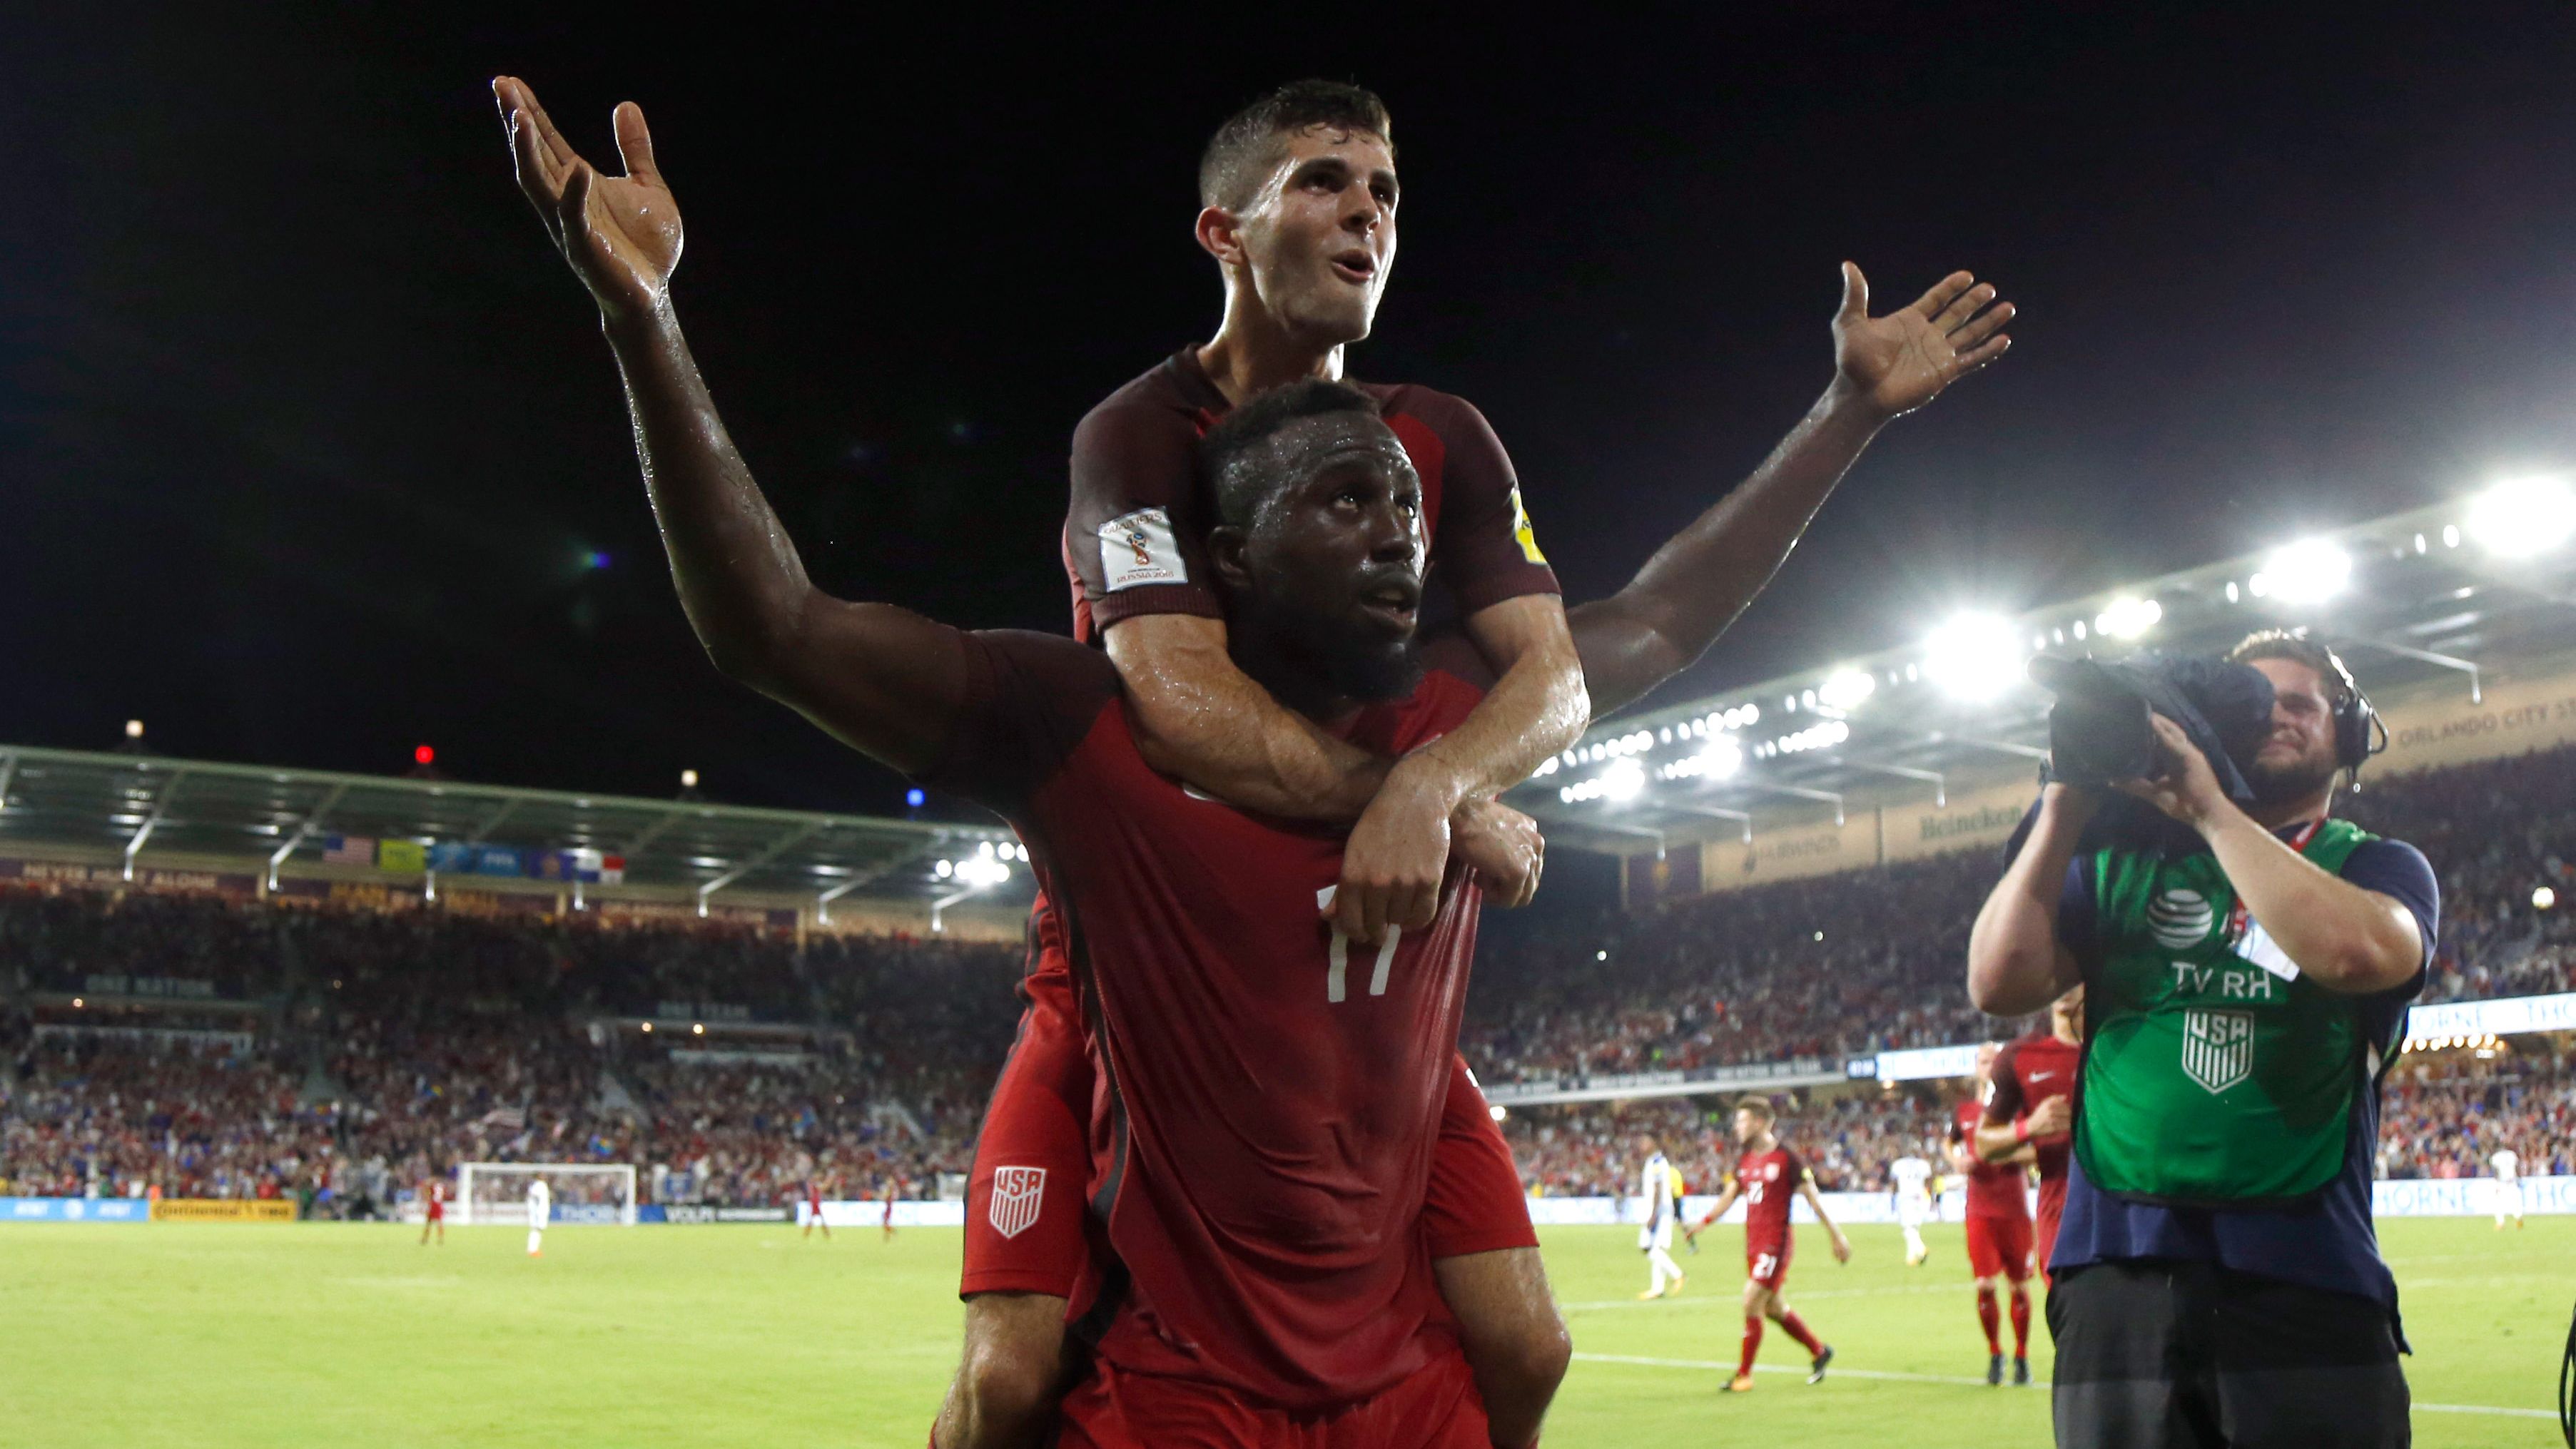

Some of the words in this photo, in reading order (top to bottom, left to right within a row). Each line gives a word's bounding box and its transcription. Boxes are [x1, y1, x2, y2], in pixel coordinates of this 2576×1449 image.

[1117, 572, 1152, 584] RUSSIA
[2398, 712, 2498, 747] ORLANDO
[2503, 703, 2549, 730] CITY
[1920, 804, 2022, 840] Heineken
[2171, 961, 2214, 994] TV
[2222, 970, 2271, 1000] RH
[2190, 1012, 2248, 1046] USA
[2408, 1003, 2487, 1030] ORNE
[998, 1169, 1042, 1197] USA
[2373, 1182, 2475, 1214] HORNE
[1752, 1253, 1778, 1279] 21
